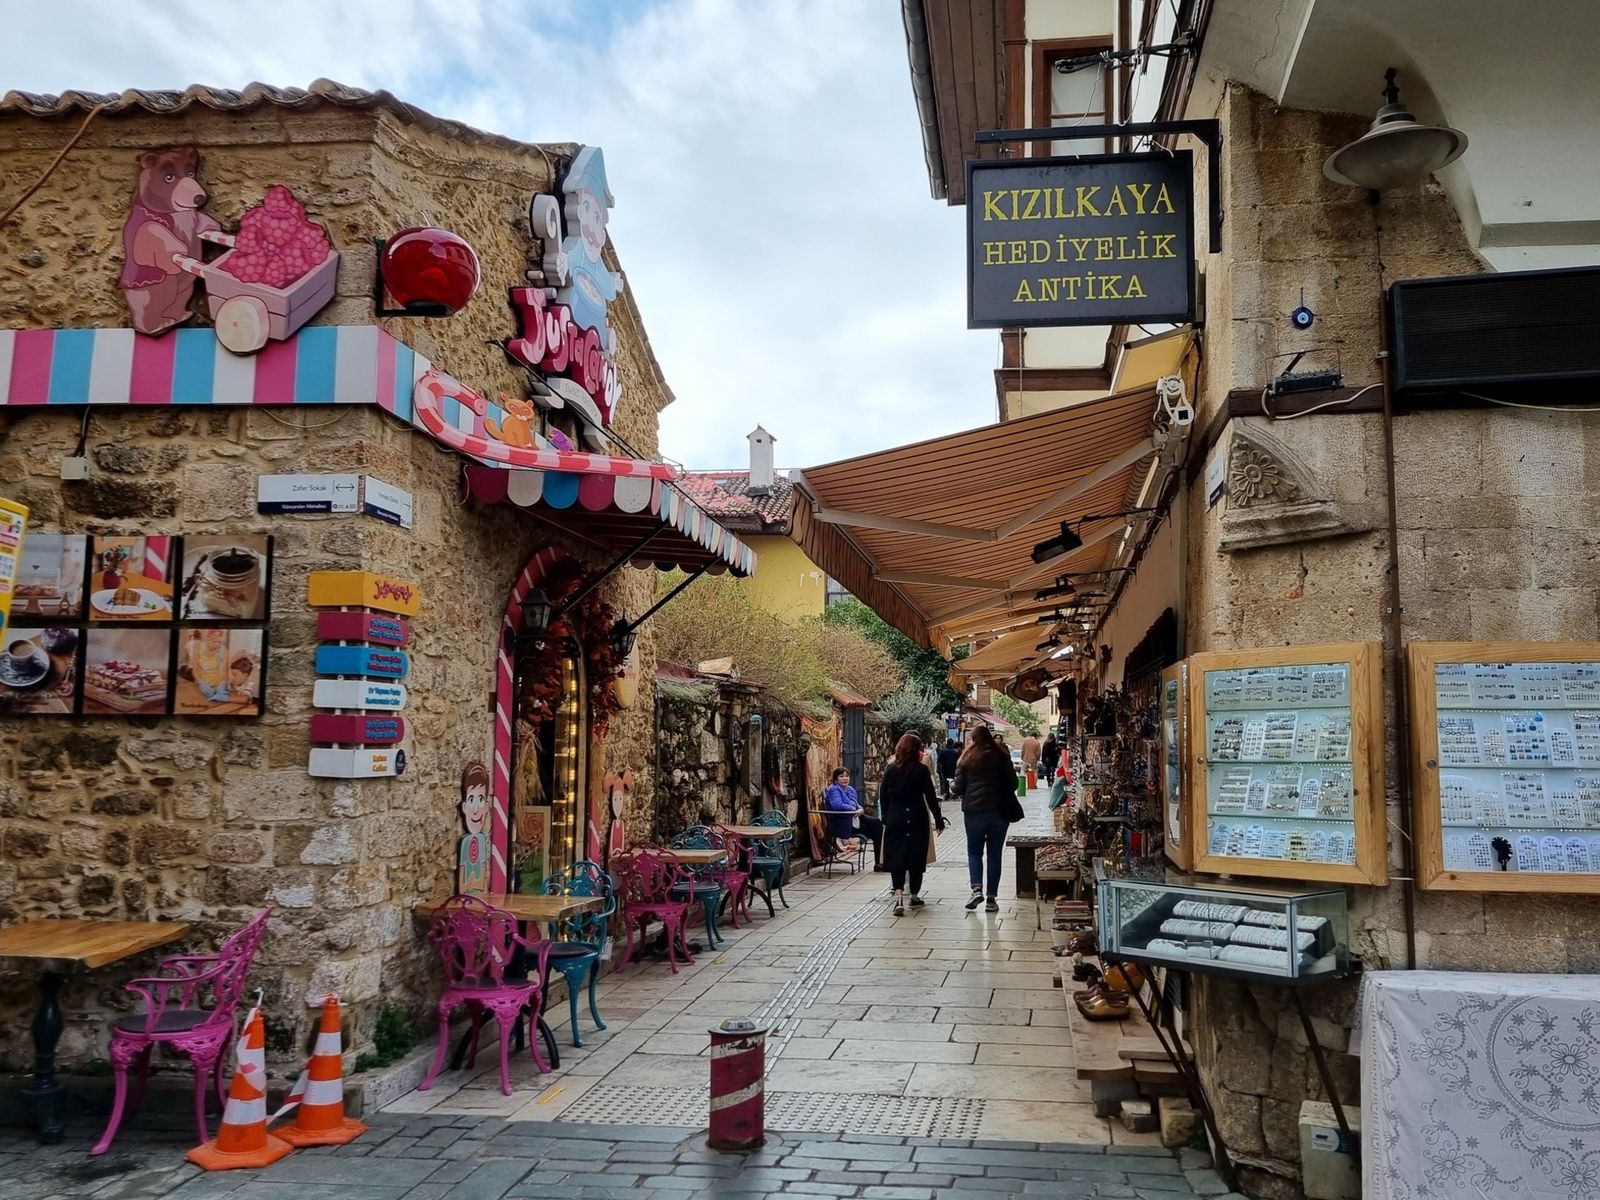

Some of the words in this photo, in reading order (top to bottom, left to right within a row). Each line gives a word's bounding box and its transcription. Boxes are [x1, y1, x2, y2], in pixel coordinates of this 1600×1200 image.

[983, 182, 1175, 221] KIZILKAYA
[983, 230, 1176, 265] HEDİYELİK
[1012, 270, 1148, 303] ANTİKA
[291, 484, 308, 492] Zafer
